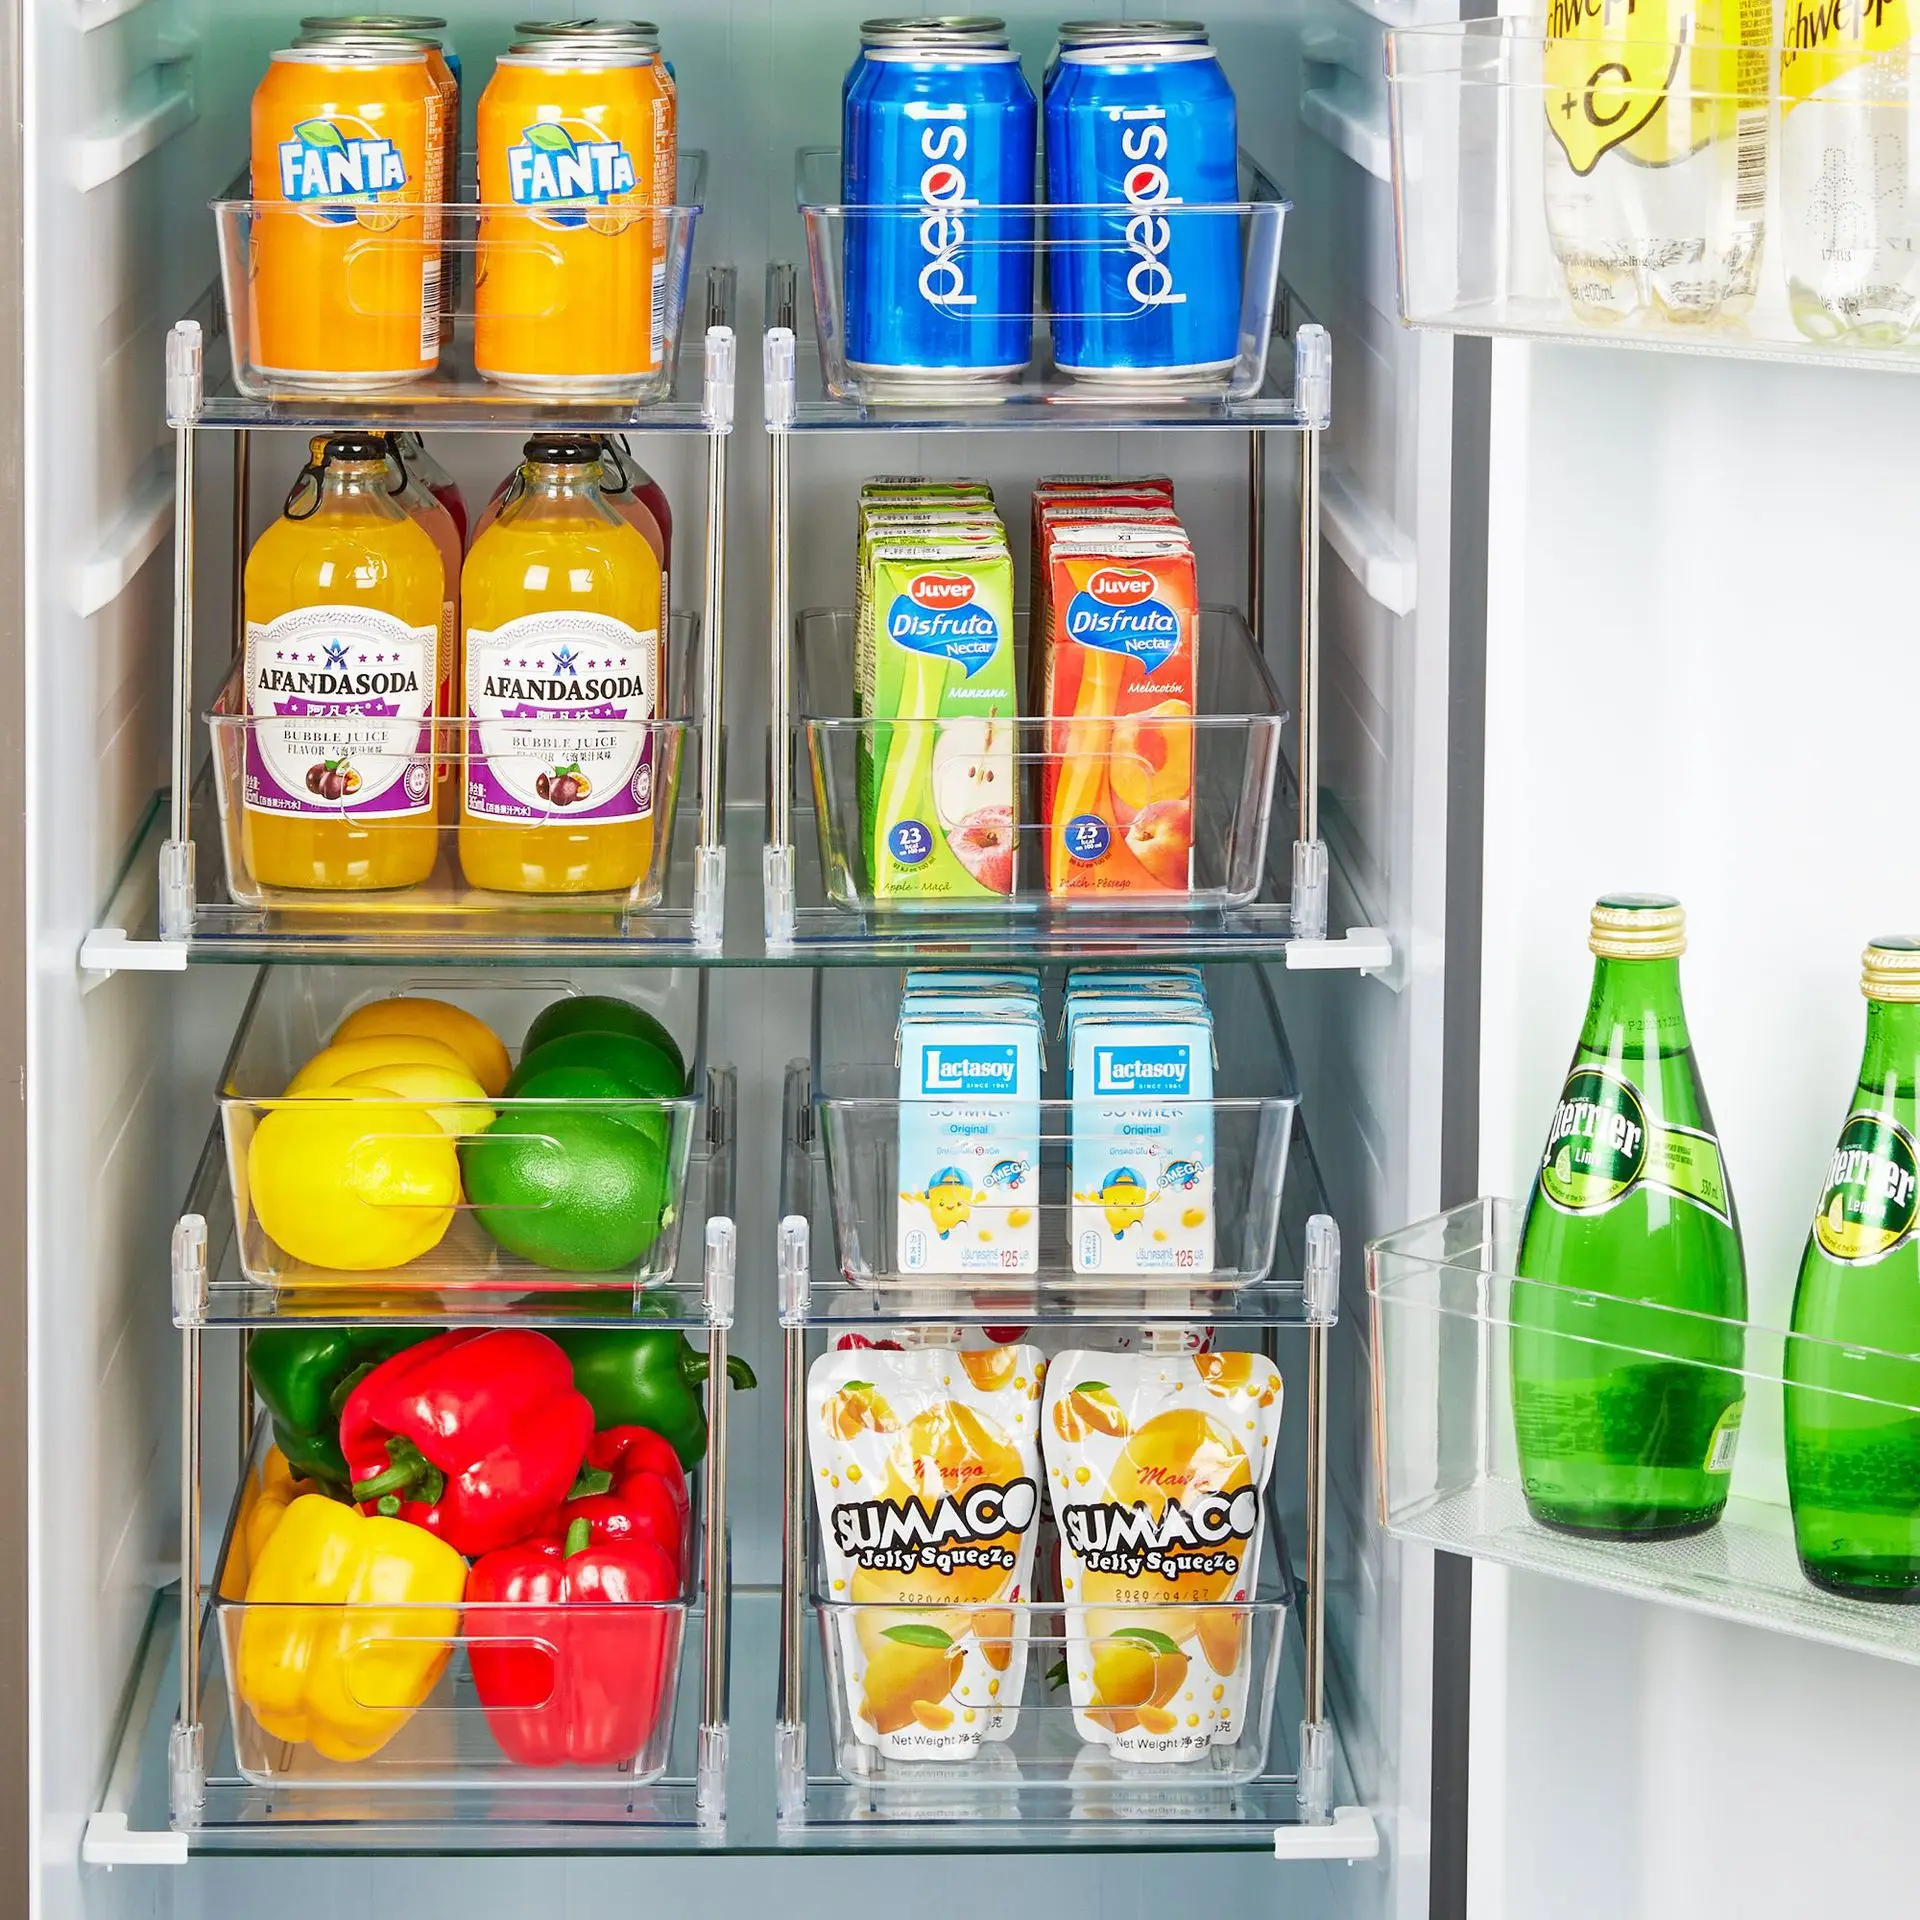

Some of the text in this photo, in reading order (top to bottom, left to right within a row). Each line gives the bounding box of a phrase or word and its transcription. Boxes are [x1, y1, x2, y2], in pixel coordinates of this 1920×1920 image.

[280, 141, 405, 196] FANTA
[509, 144, 634, 200] FANTA
[904, 102, 979, 305] pepsi
[1109, 105, 1186, 304] pepsi
[915, 582, 972, 598] Juver
[1094, 578, 1150, 594] Juver
[893, 614, 994, 637] Disfruta
[1073, 610, 1173, 634] Disfruta
[946, 642, 992, 656] Nectar
[1125, 638, 1172, 652] Nectar
[258, 668, 419, 695] AFANDASODA
[483, 675, 644, 701] AFANDASODA
[1127, 681, 1184, 694] Melocotón
[284, 731, 389, 744] BUBBLE JUICE
[512, 736, 617, 750] BUBBLE JUICE
[288, 744, 325, 755] FLAVOR
[899, 828, 921, 845] 23
[1075, 823, 1098, 840] 23
[926, 1050, 1014, 1089] Lactasoy
[1098, 1052, 1187, 1089] Lactasoy
[950, 1124, 988, 1136] Original
[1575, 1147, 1603, 1165] Lim
[983, 1160, 1030, 1187] OMEGA
[1157, 1161, 1204, 1188] OMEGA
[1000, 1250, 1018, 1267] 125
[1175, 1250, 1193, 1267] 125
[1136, 1466, 1209, 1489] Man
[837, 1483, 1035, 1550] SUMACO
[1067, 1490, 1256, 1552] SUMACO
[860, 1546, 1014, 1573] Jelly Squeeze
[1087, 1551, 1237, 1579] Jelly Squeeze
[891, 1735, 911, 1746] Net
[914, 1735, 956, 1748] Weight
[1116, 1737, 1134, 1749] Net
[1137, 1737, 1178, 1752] Weight
